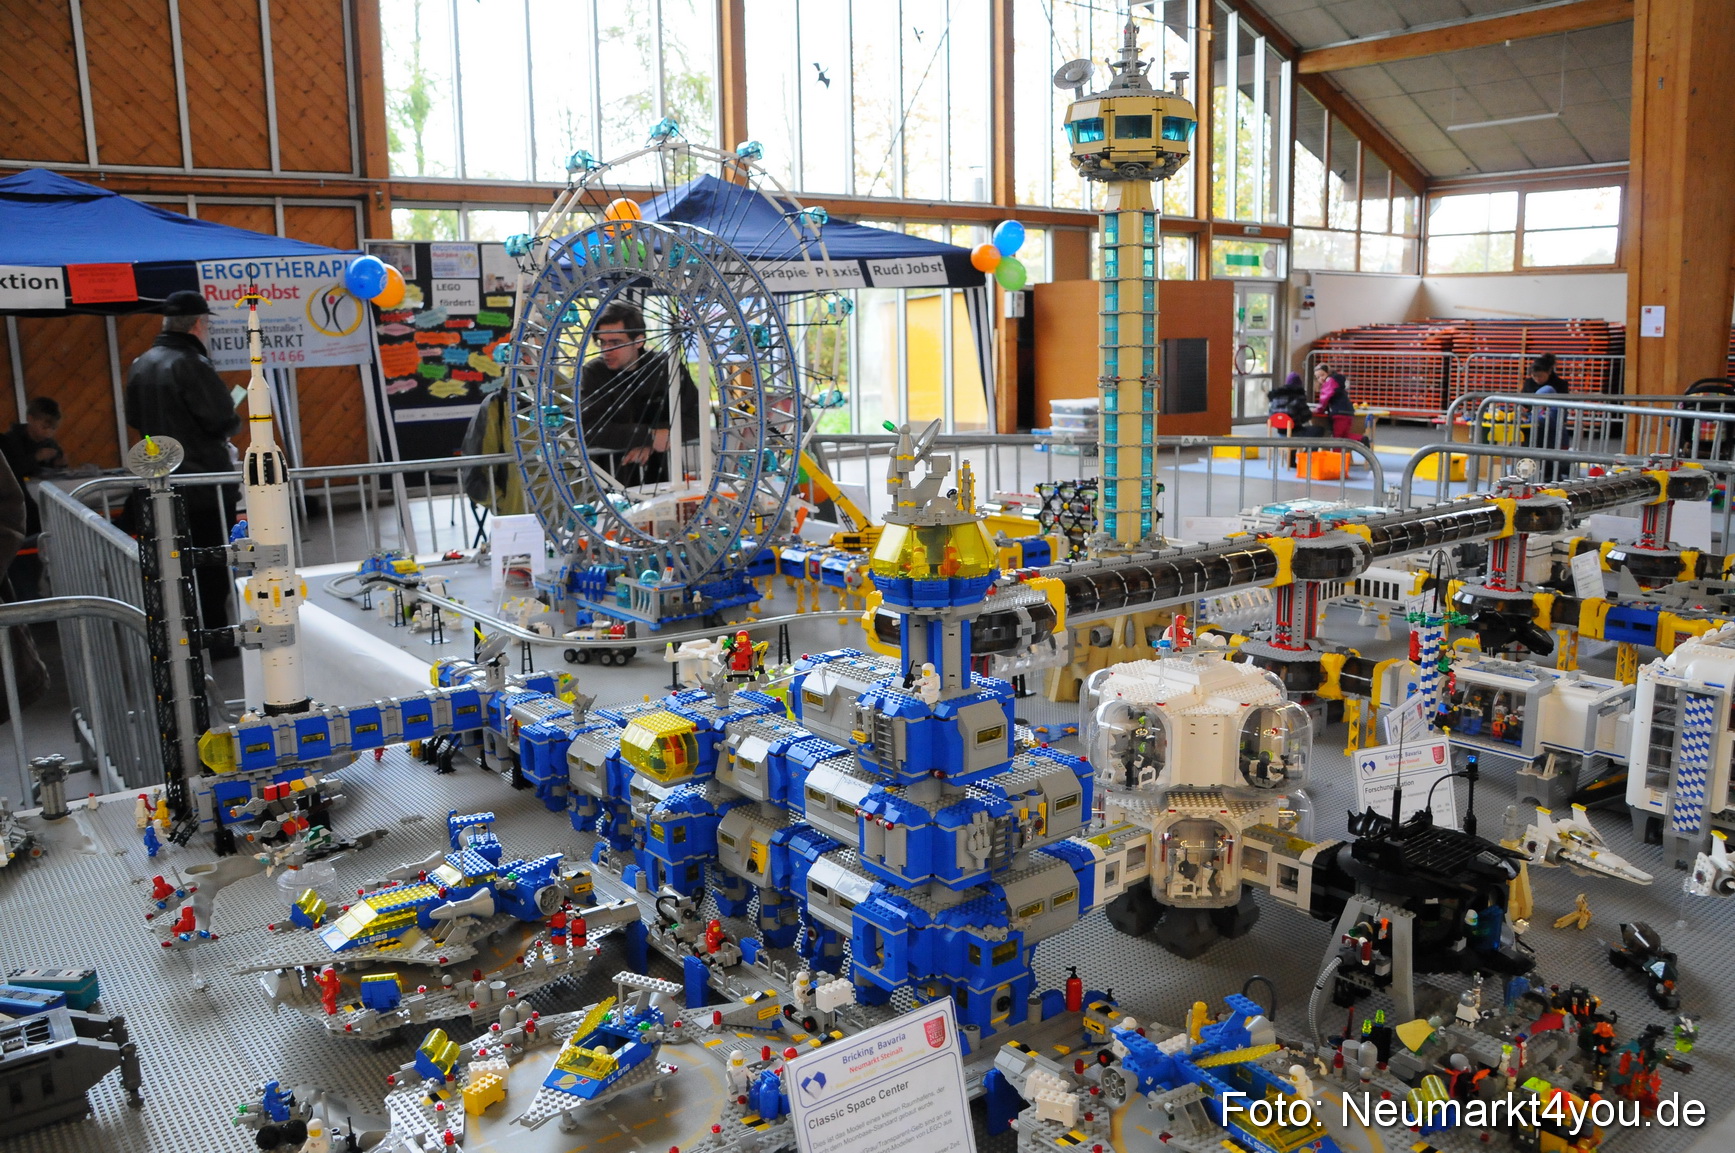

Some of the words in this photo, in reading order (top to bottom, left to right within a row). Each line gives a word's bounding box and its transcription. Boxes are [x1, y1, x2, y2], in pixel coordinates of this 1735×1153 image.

[201, 260, 347, 279] ERGOTHERAPI
[762, 267, 809, 280] erapie-
[873, 263, 903, 276] Rudi
[907, 262, 943, 275] Jobst
[211, 335, 304, 350] NEUARKT
[842, 1046, 874, 1065] Bricking
[878, 1033, 906, 1050] Bavaria
[849, 1056, 880, 1073] Neumarkt
[808, 1107, 845, 1130] Classic
[847, 1094, 877, 1113] Space
[878, 1080, 909, 1101] Center
[812, 1138, 826, 1149] Dies
[834, 1130, 846, 1139] das
[845, 1121, 866, 1134] Modell
[935, 1085, 945, 1093] der
[924, 1121, 943, 1133] LEGO
